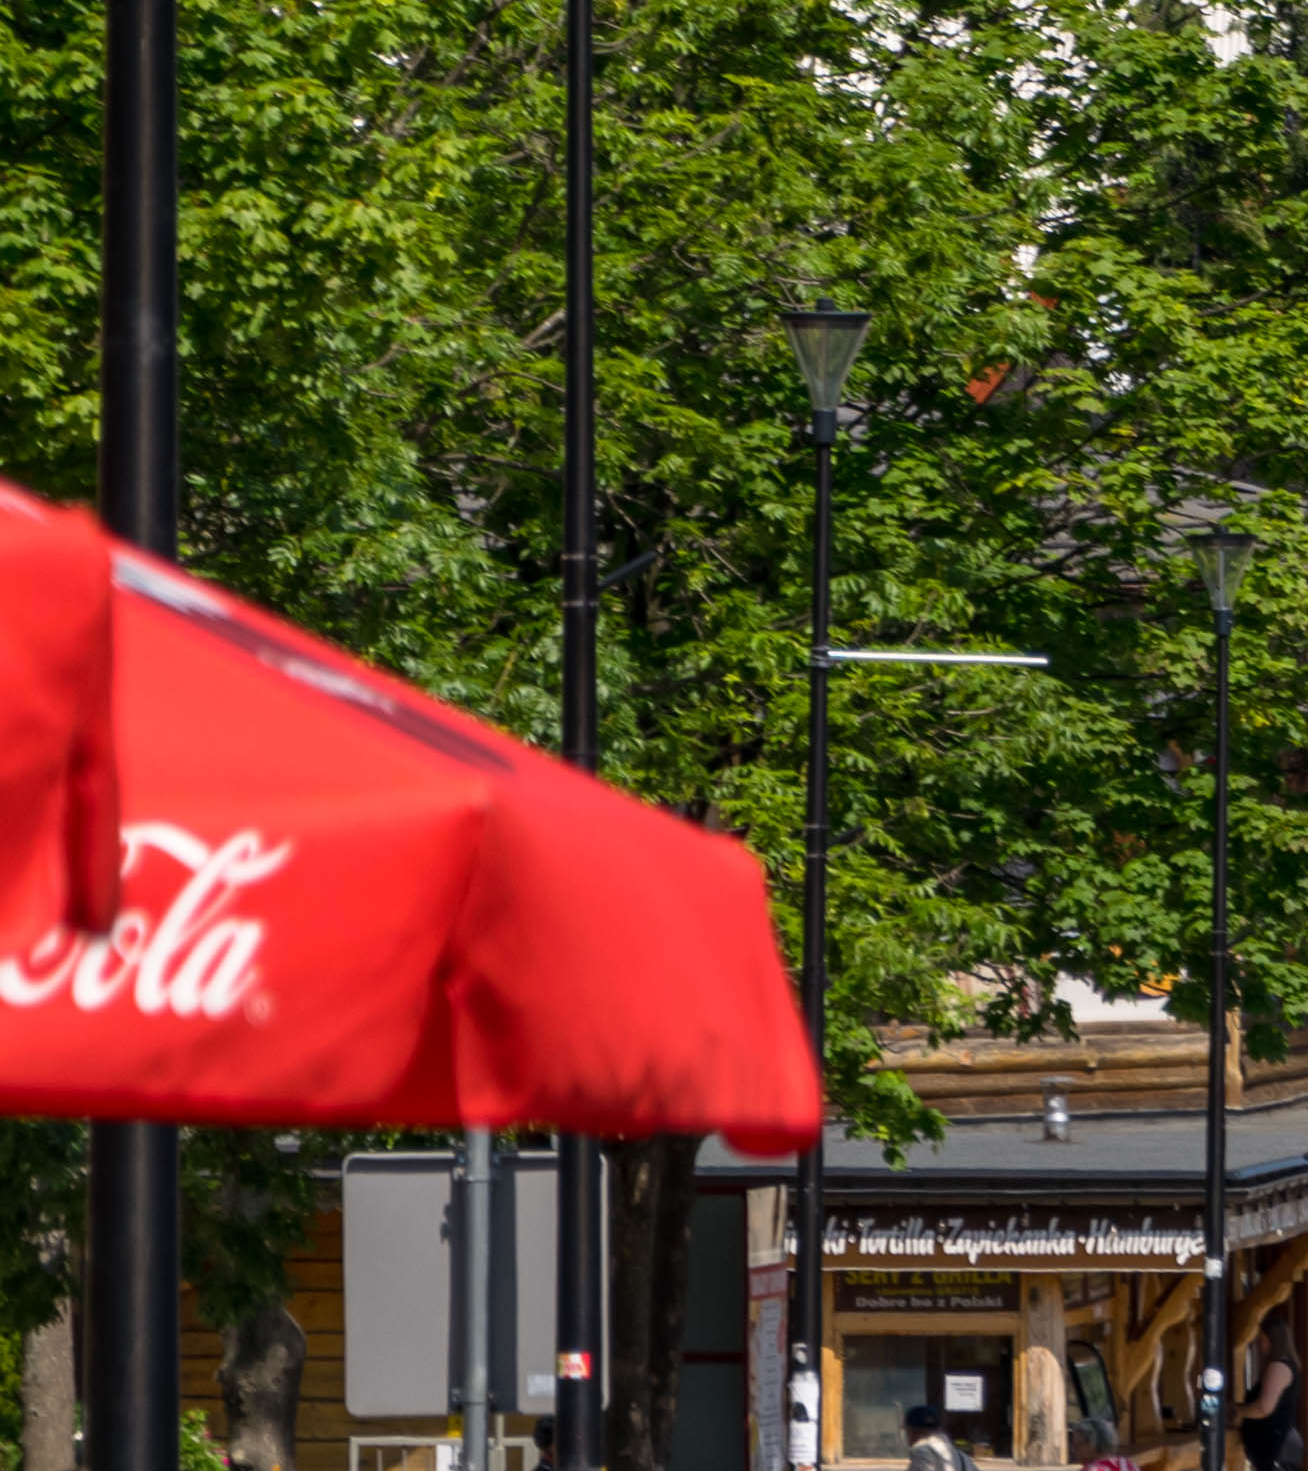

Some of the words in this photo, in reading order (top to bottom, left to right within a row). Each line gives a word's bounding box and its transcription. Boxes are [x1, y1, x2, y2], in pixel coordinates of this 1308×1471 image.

[857, 1218, 935, 1255] Tortilla
[942, 1217, 1076, 1266] Zapiekanka
[1084, 1217, 1207, 1266] Hamburge
[855, 1296, 907, 1308] Dobre
[910, 1296, 932, 1308] bo
[950, 1296, 1003, 1308] Polski
